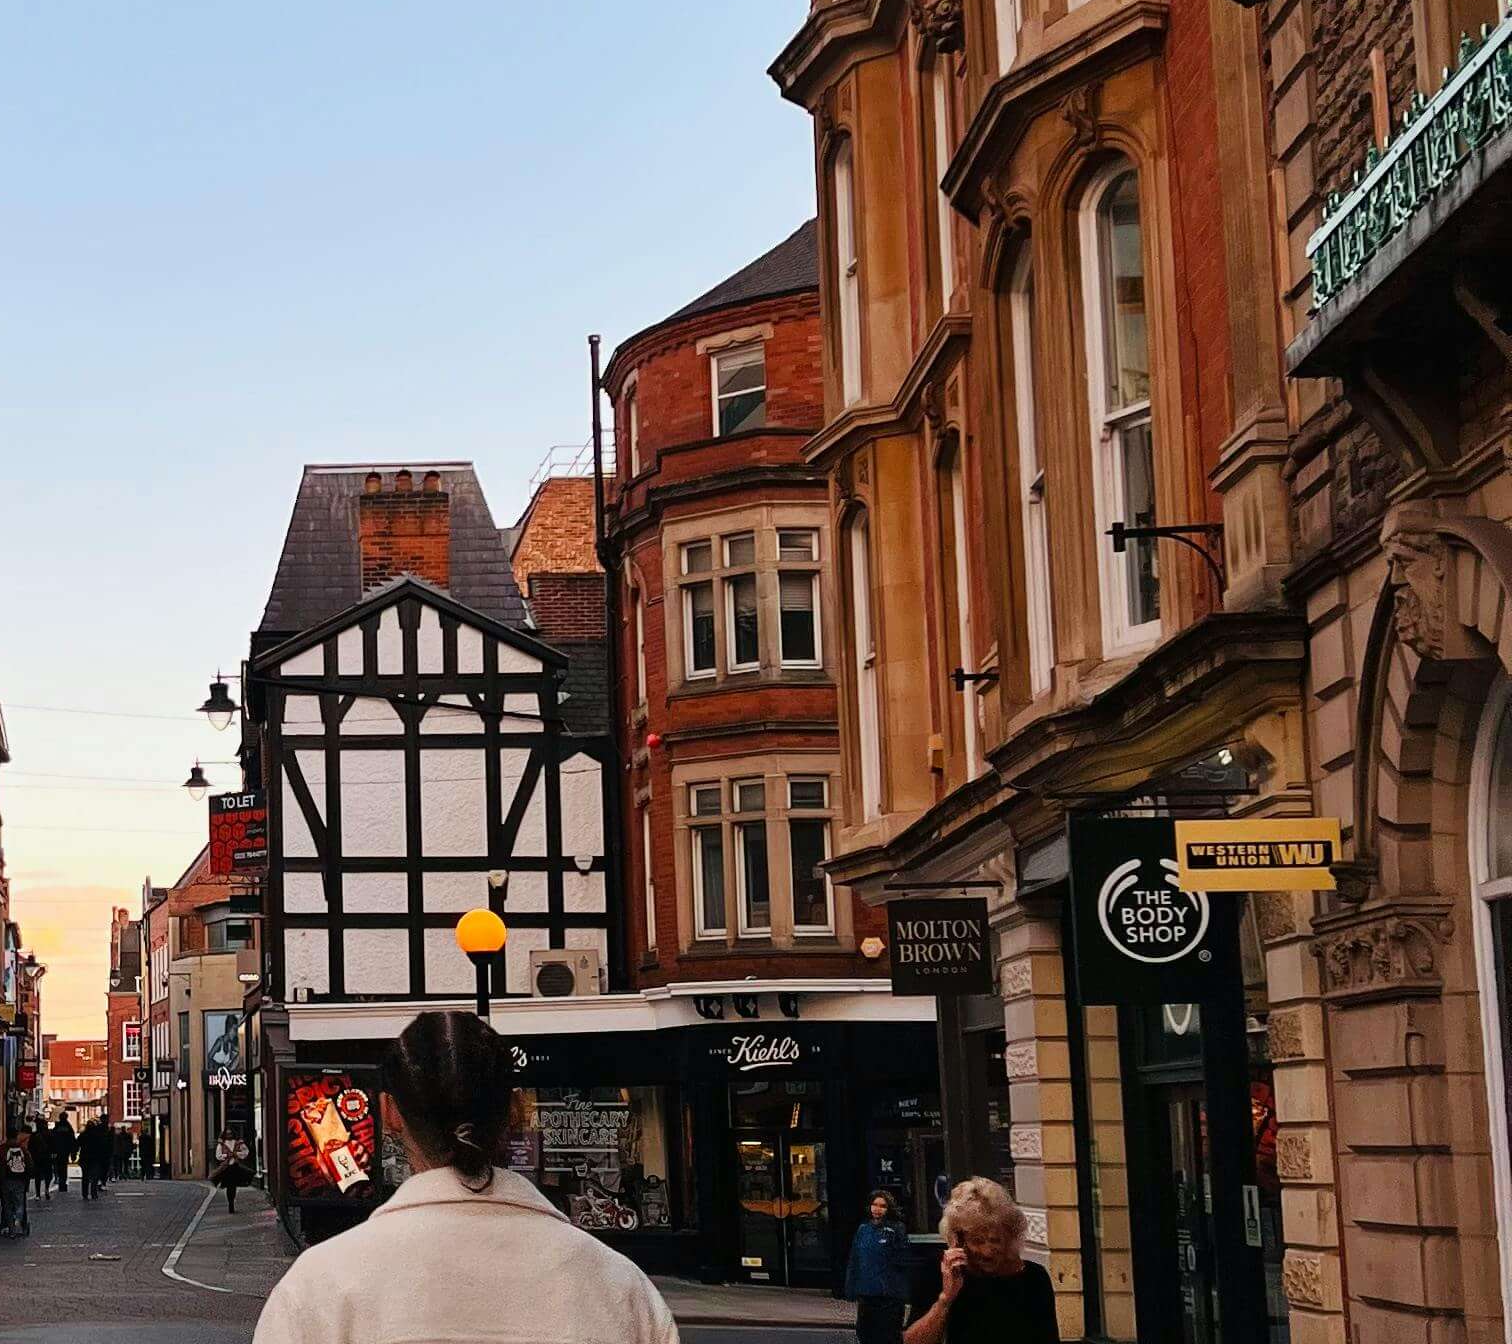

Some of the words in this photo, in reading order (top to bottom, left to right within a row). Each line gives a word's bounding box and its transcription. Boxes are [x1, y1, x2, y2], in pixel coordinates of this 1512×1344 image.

[220, 798, 236, 809] TO
[236, 795, 256, 808] LET
[1190, 844, 1270, 856] WESTERN
[1276, 843, 1324, 865] WU
[1216, 855, 1271, 866] UNION
[1133, 890, 1172, 905] THE
[1121, 906, 1188, 925] BODY
[896, 920, 981, 940] MOLTON
[1125, 926, 1187, 943] SHOP
[898, 943, 981, 963] BROWN
[915, 966, 968, 975] LONDON
[727, 1034, 800, 1065] Kiehl's
[562, 1092, 594, 1111] Fine
[530, 1110, 630, 1129] APOTHECARY
[542, 1128, 619, 1146] SKINCARE
